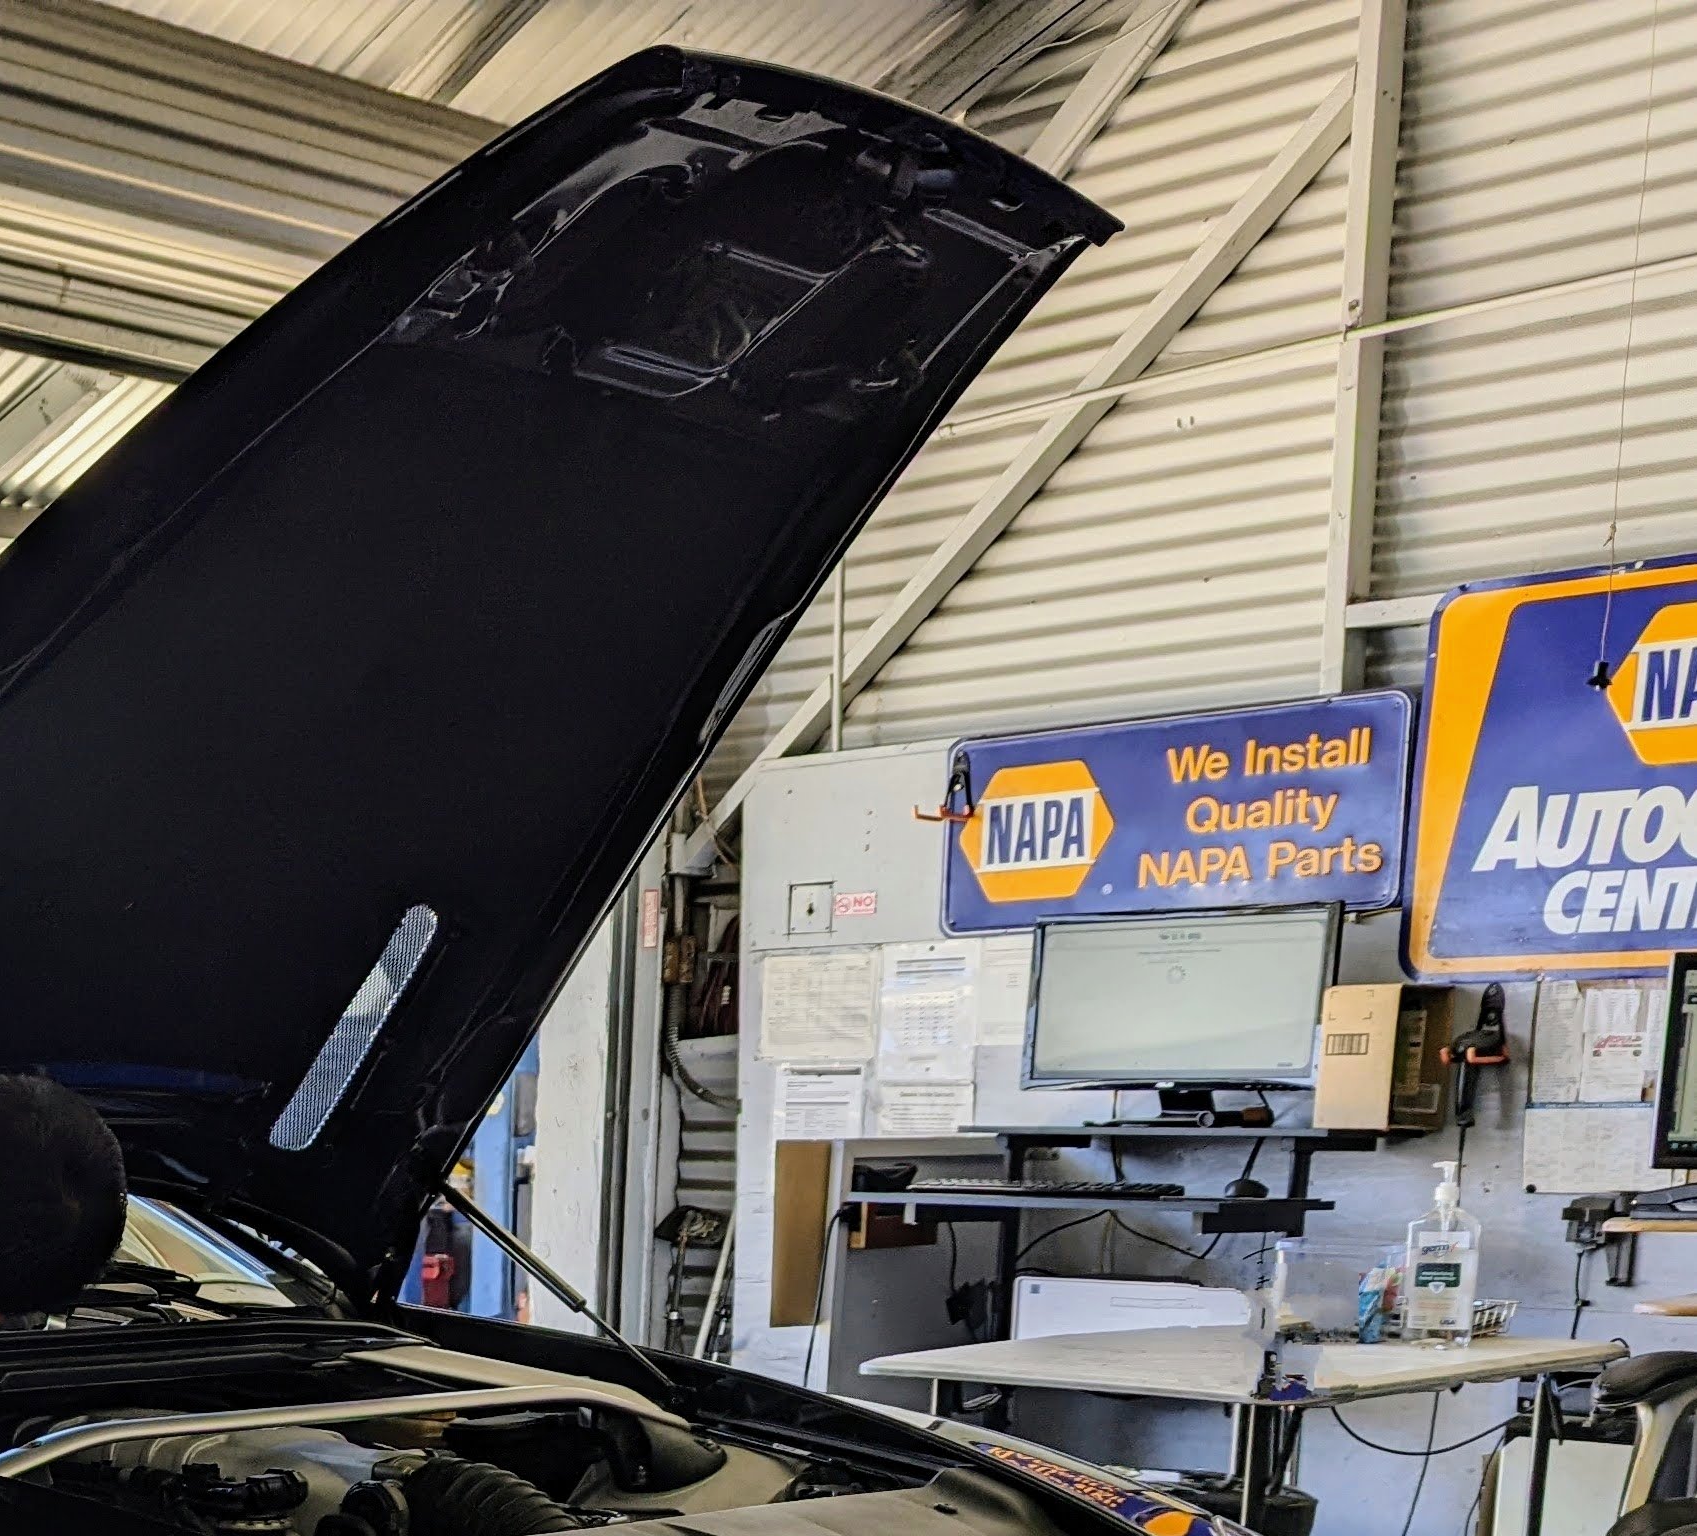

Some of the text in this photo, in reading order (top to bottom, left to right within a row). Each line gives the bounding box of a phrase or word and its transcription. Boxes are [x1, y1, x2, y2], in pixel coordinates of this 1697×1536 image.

[1166, 726, 1372, 784] We Install
[986, 796, 1086, 866] NAPA
[1185, 788, 1338, 834] Quality
[1137, 836, 1383, 889] NAPA Parts
